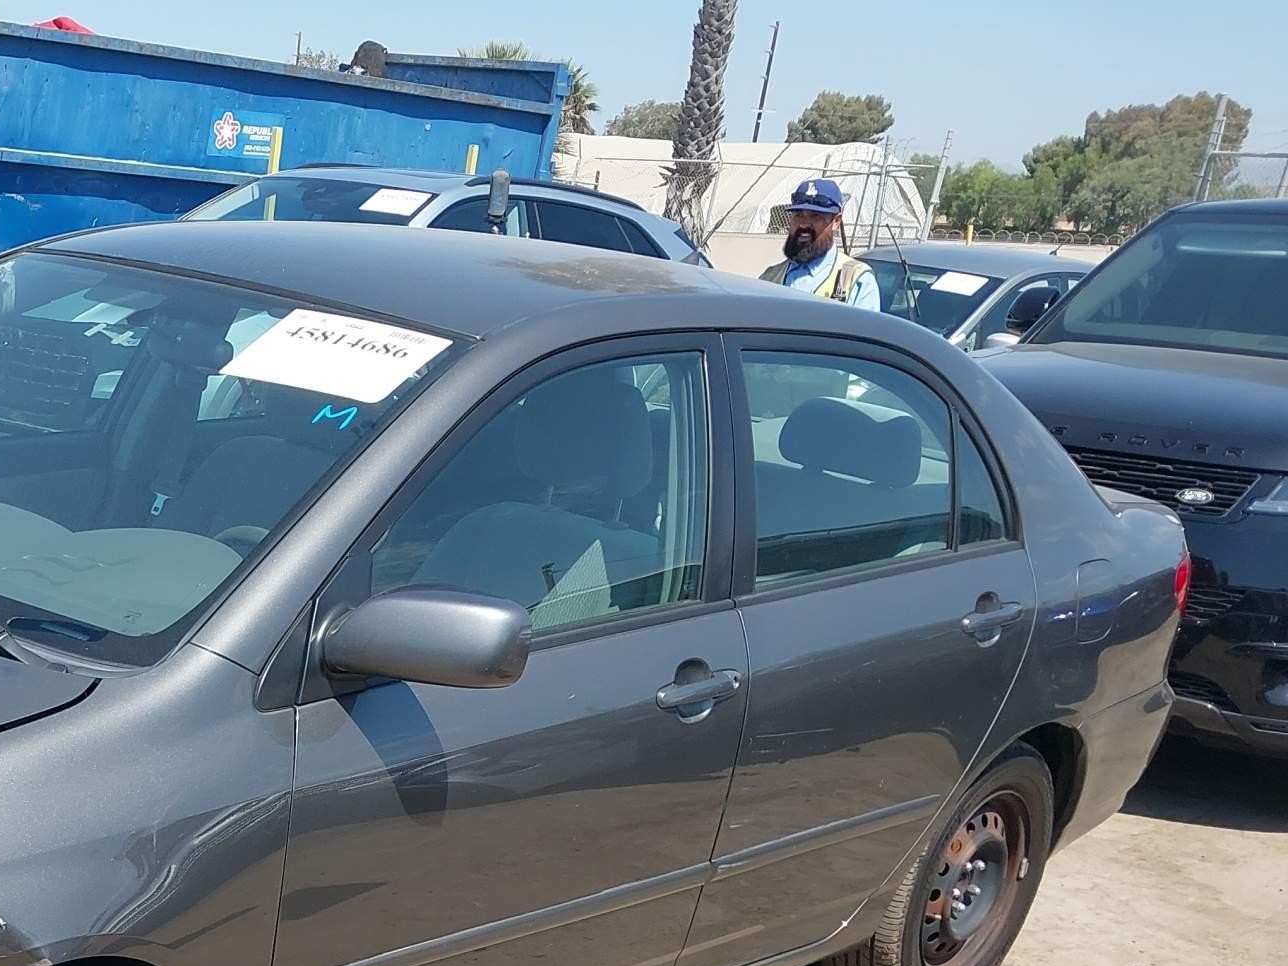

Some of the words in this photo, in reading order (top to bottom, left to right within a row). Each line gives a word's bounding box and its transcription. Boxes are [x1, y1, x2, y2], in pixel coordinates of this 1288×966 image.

[242, 125, 273, 136] REPUBL
[286, 326, 409, 359] 45814686
[312, 404, 359, 430] M
[1097, 432, 1245, 457] ROVER
